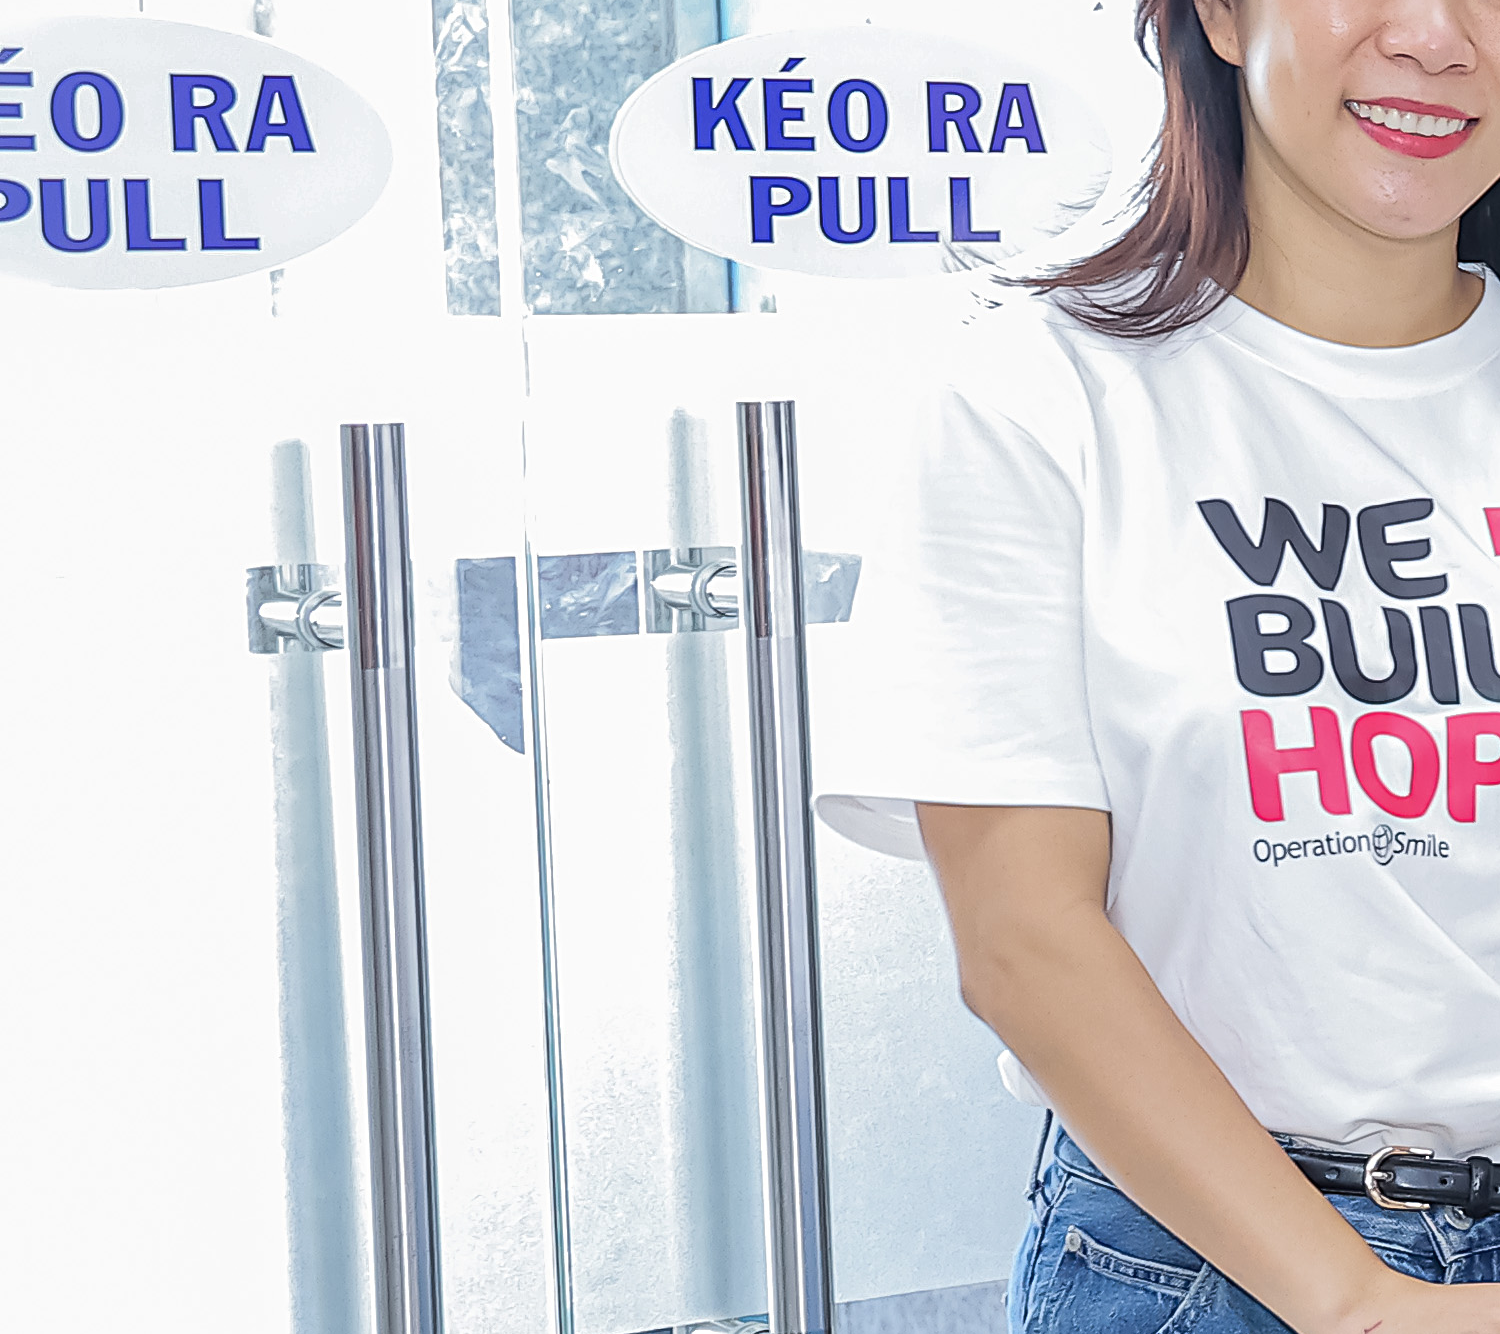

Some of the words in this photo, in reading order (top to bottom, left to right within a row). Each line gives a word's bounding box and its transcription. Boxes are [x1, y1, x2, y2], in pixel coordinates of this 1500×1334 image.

[0, 48, 124, 153] ÉO
[170, 73, 317, 153] RA
[690, 56, 889, 154] KÉO
[925, 82, 1047, 155] RA
[748, 176, 1000, 245] PULL
[1195, 497, 1448, 600] WE
[1253, 829, 1371, 867] Operation
[1393, 832, 1450, 859] Smile
